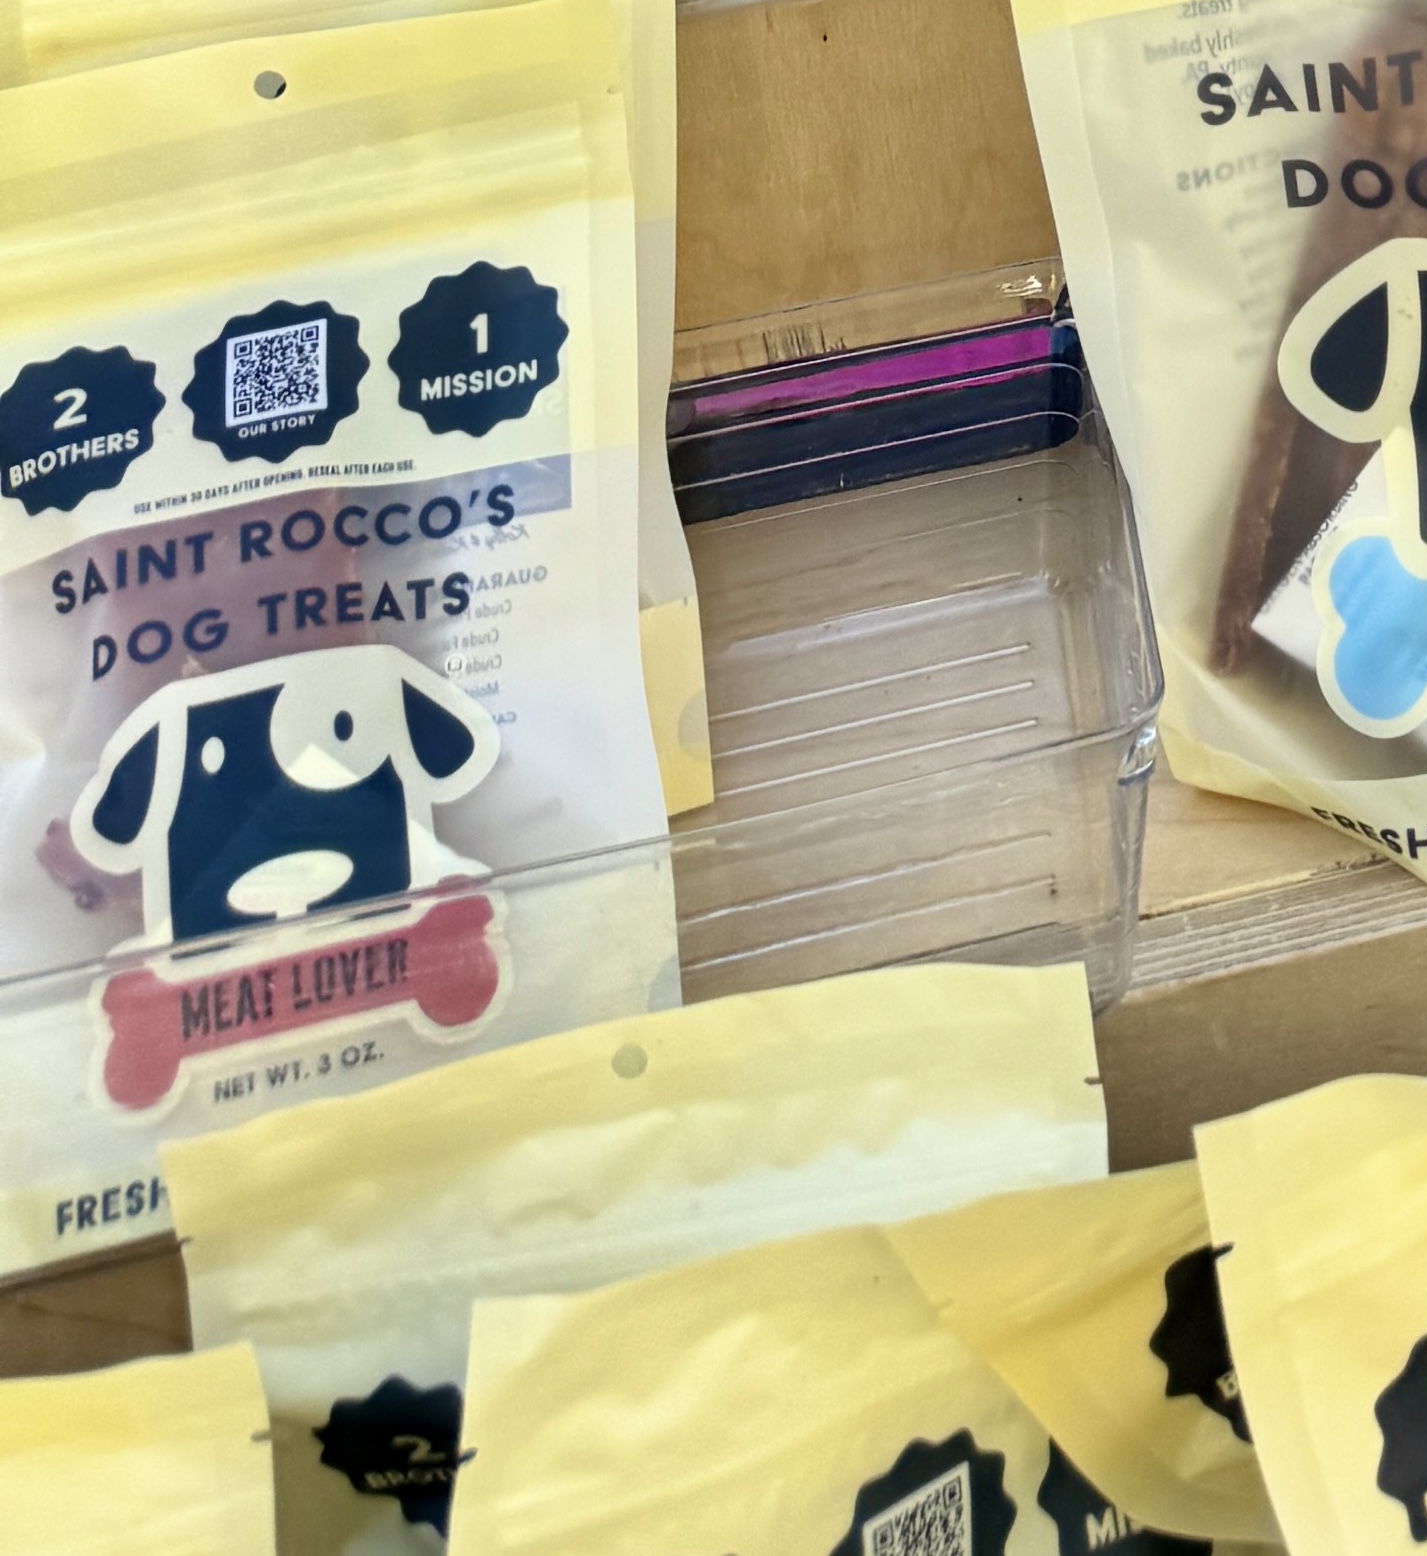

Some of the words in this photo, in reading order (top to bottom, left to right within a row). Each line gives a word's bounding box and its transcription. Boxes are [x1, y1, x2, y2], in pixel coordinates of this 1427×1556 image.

[1197, 51, 1422, 126] SAINT
[470, 313, 488, 354] 1
[421, 359, 537, 400] MISSION
[53, 388, 87, 430] 2
[238, 424, 266, 438] OUR
[272, 415, 314, 431] STORY
[9, 429, 138, 487] BROTHERS
[51, 533, 215, 614] SAINT
[238, 481, 516, 563] ROCCO'S
[92, 610, 229, 681] DOG
[257, 572, 472, 636] TREATS
[181, 969, 276, 1041] MEAT
[291, 940, 408, 1011] LOVER
